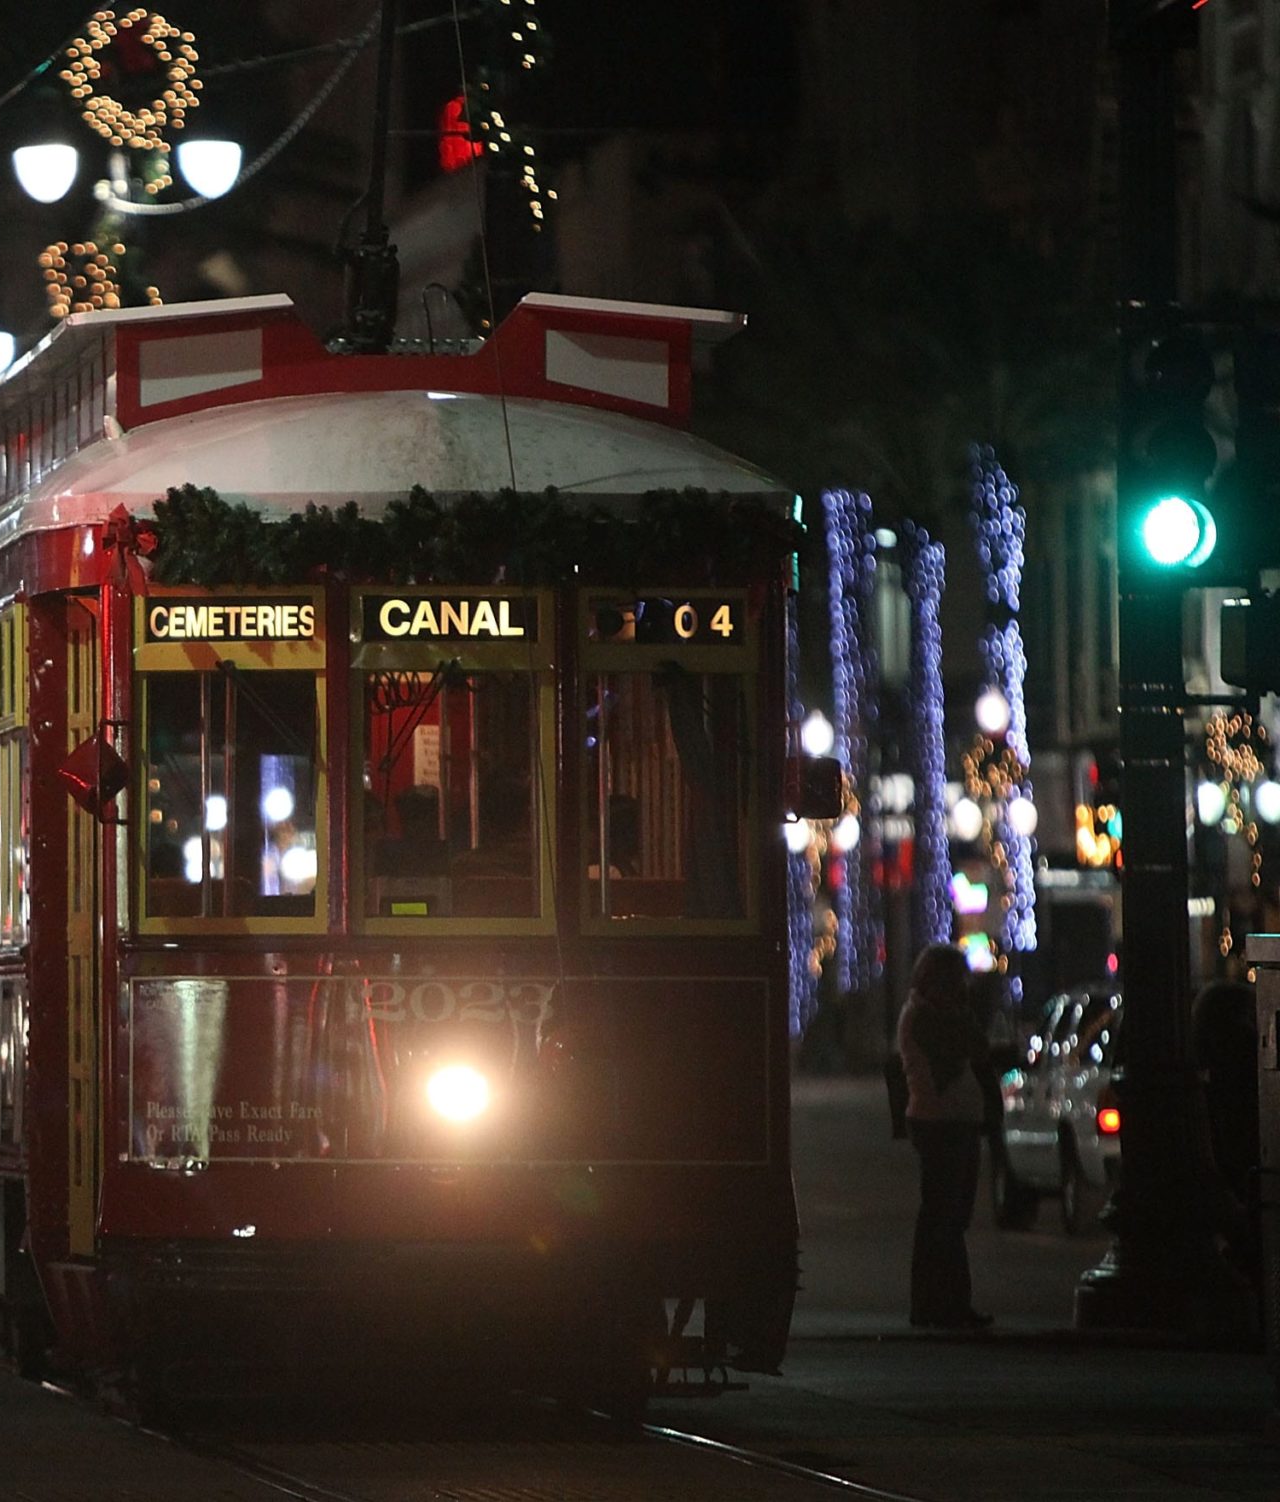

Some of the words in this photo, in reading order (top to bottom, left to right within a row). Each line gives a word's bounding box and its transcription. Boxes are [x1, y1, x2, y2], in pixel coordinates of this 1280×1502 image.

[150, 605, 315, 637] CEMETERIES
[379, 599, 525, 636] CANAL
[361, 981, 554, 1023] 2023
[200, 1101, 233, 1119] ave
[239, 1101, 283, 1120] Exact
[290, 1101, 322, 1119] Fare
[146, 1124, 165, 1142] Or
[171, 1124, 201, 1142] RTA
[209, 1125, 240, 1142] Pass
[247, 1125, 293, 1144] Ready
